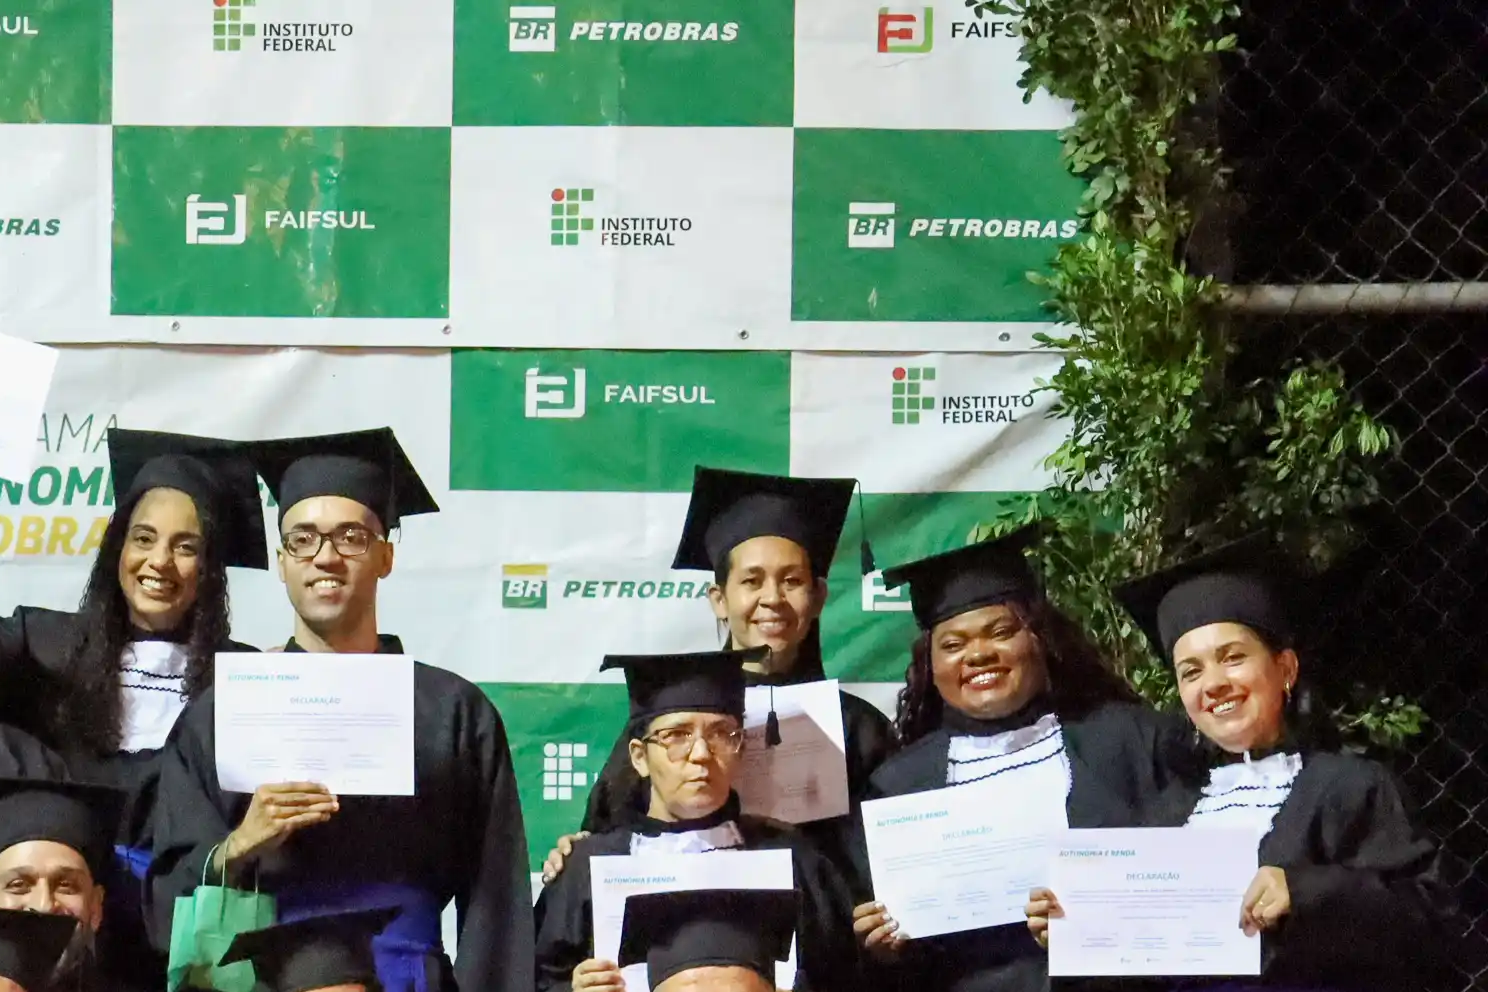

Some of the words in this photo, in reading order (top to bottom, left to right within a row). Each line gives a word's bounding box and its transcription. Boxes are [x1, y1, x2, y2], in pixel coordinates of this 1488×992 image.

[263, 22, 354, 38] INSTITUTO
[513, 21, 552, 41] BR
[569, 22, 739, 42] PETROBRAS
[263, 38, 336, 52] FEDERAL
[264, 210, 375, 230] FAIFSUL
[600, 217, 693, 233] INSTITUTO
[852, 217, 892, 237] BR
[909, 218, 1078, 239] PETROBRAS
[600, 232, 675, 247] FEDERAL
[604, 384, 715, 405] FAIFSUL
[942, 394, 1034, 410] INSTITUTO
[942, 409, 1018, 425] FEDERAL
[504, 579, 545, 599] BR
[563, 580, 710, 599] PETROBRA
